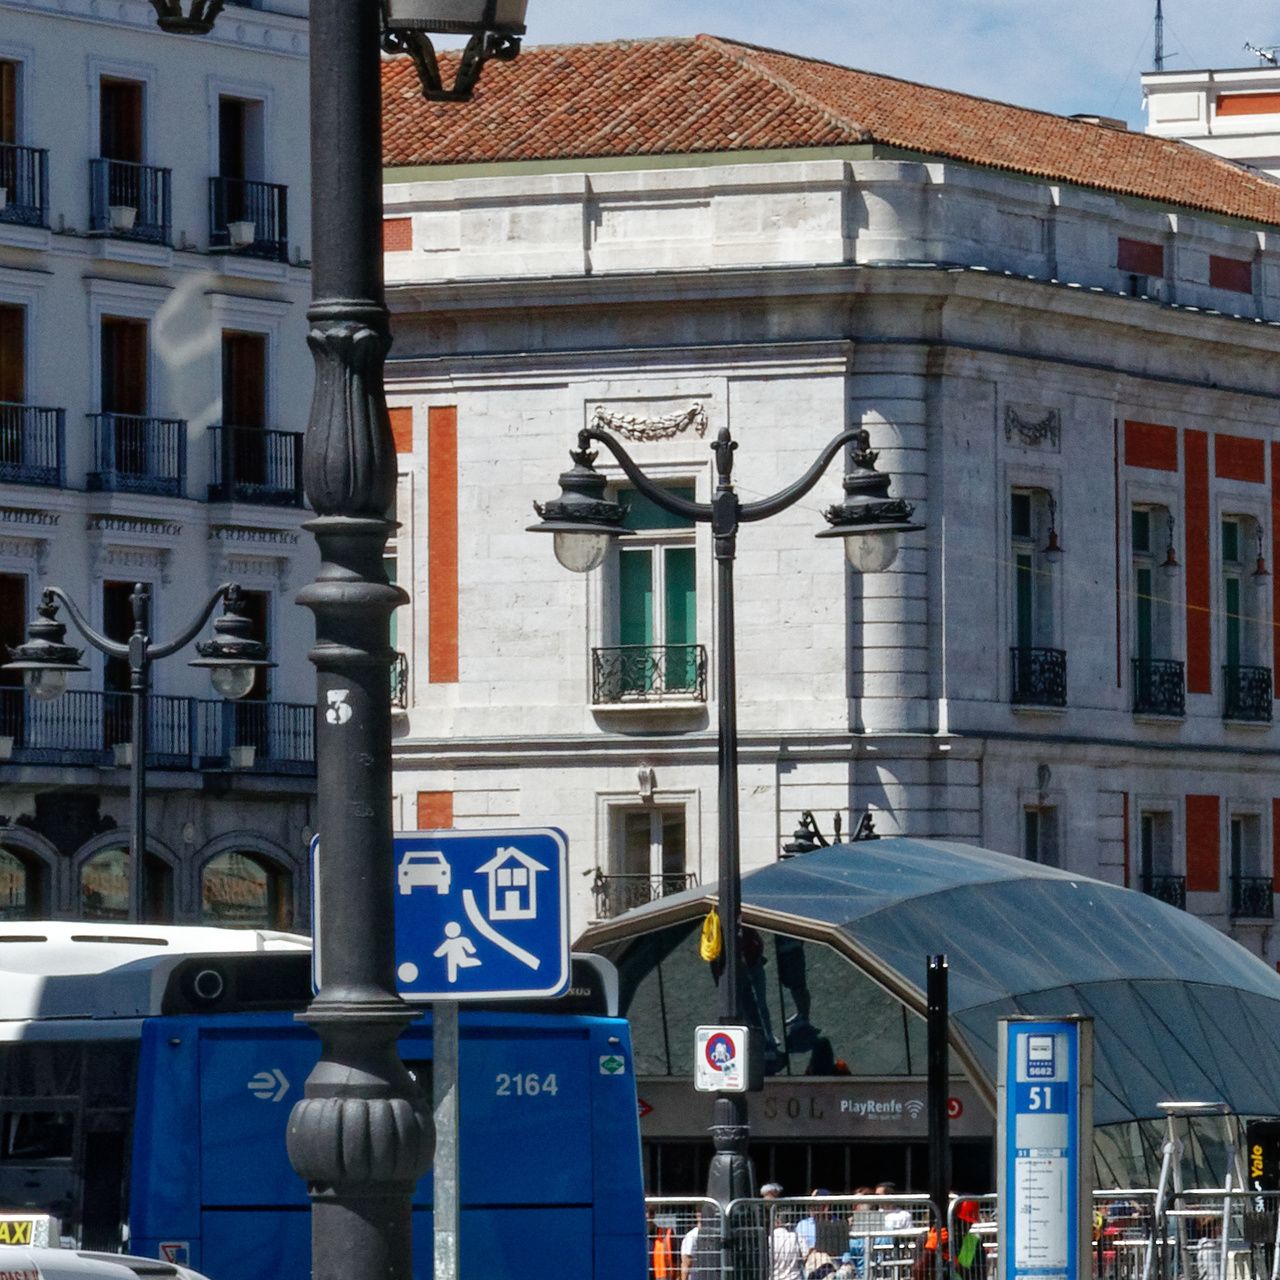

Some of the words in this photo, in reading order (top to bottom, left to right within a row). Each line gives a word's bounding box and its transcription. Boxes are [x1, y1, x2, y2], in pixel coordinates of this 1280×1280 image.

[325, 689, 353, 725] 3
[495, 1073, 559, 1096] 2164
[764, 1096, 824, 1120] SOL
[840, 1099, 903, 1116] PlayRenfe
[1028, 1086, 1052, 1111] 51
[1250, 1144, 1264, 1178] Yale
